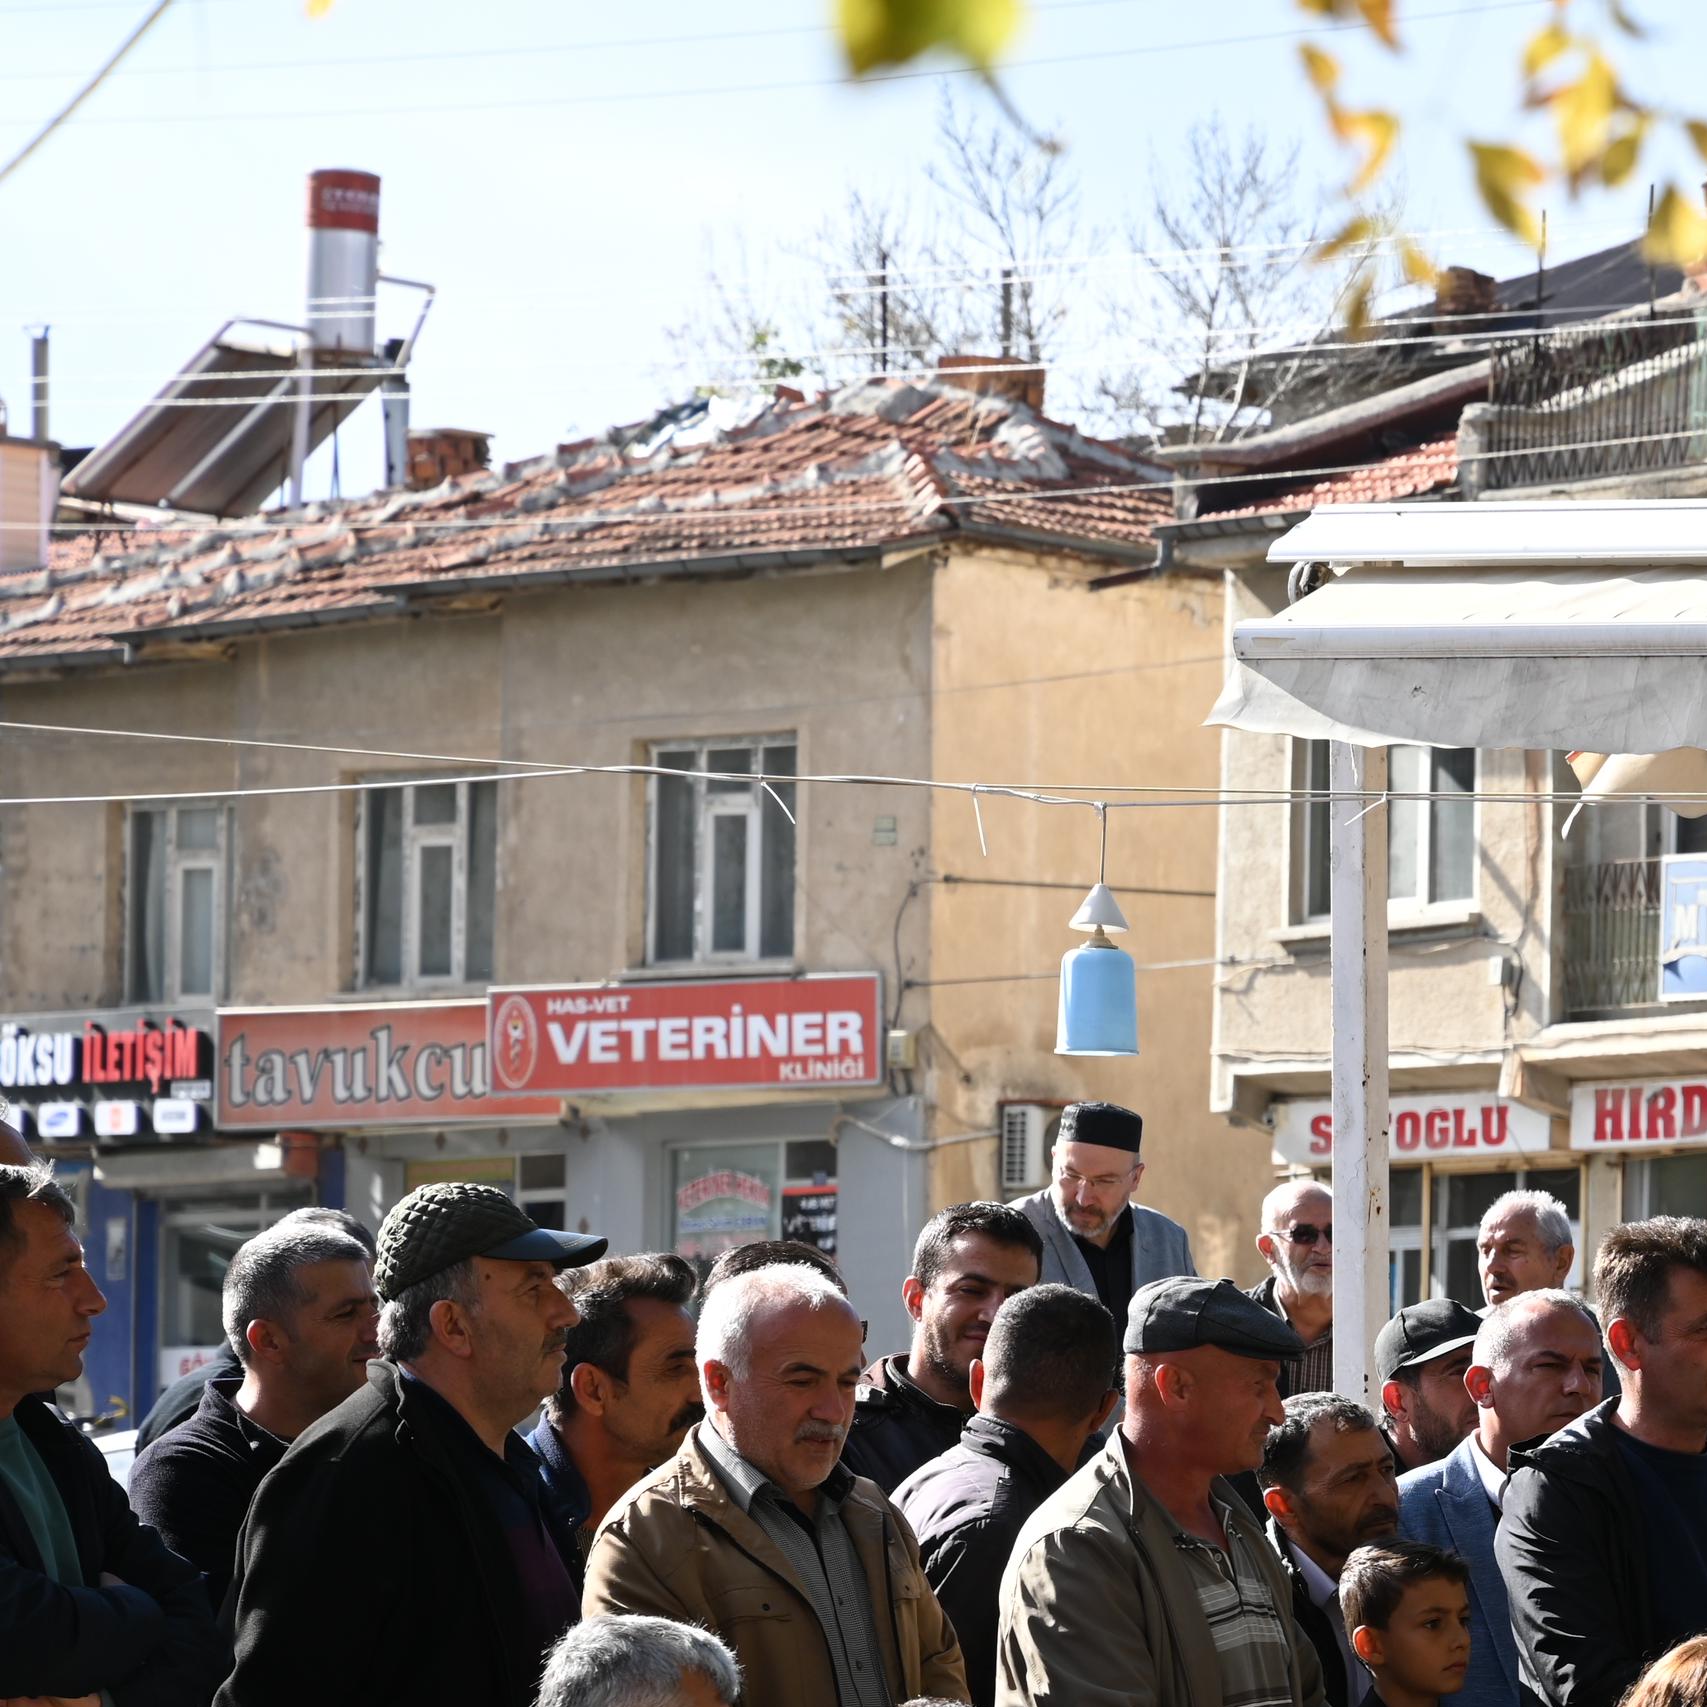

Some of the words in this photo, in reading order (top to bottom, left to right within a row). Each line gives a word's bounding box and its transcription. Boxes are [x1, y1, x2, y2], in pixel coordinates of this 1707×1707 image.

[546, 996, 631, 1015] HAS-VET
[547, 1004, 865, 1066] VETERİNER
[82, 1015, 198, 1095] İLETİŞİM
